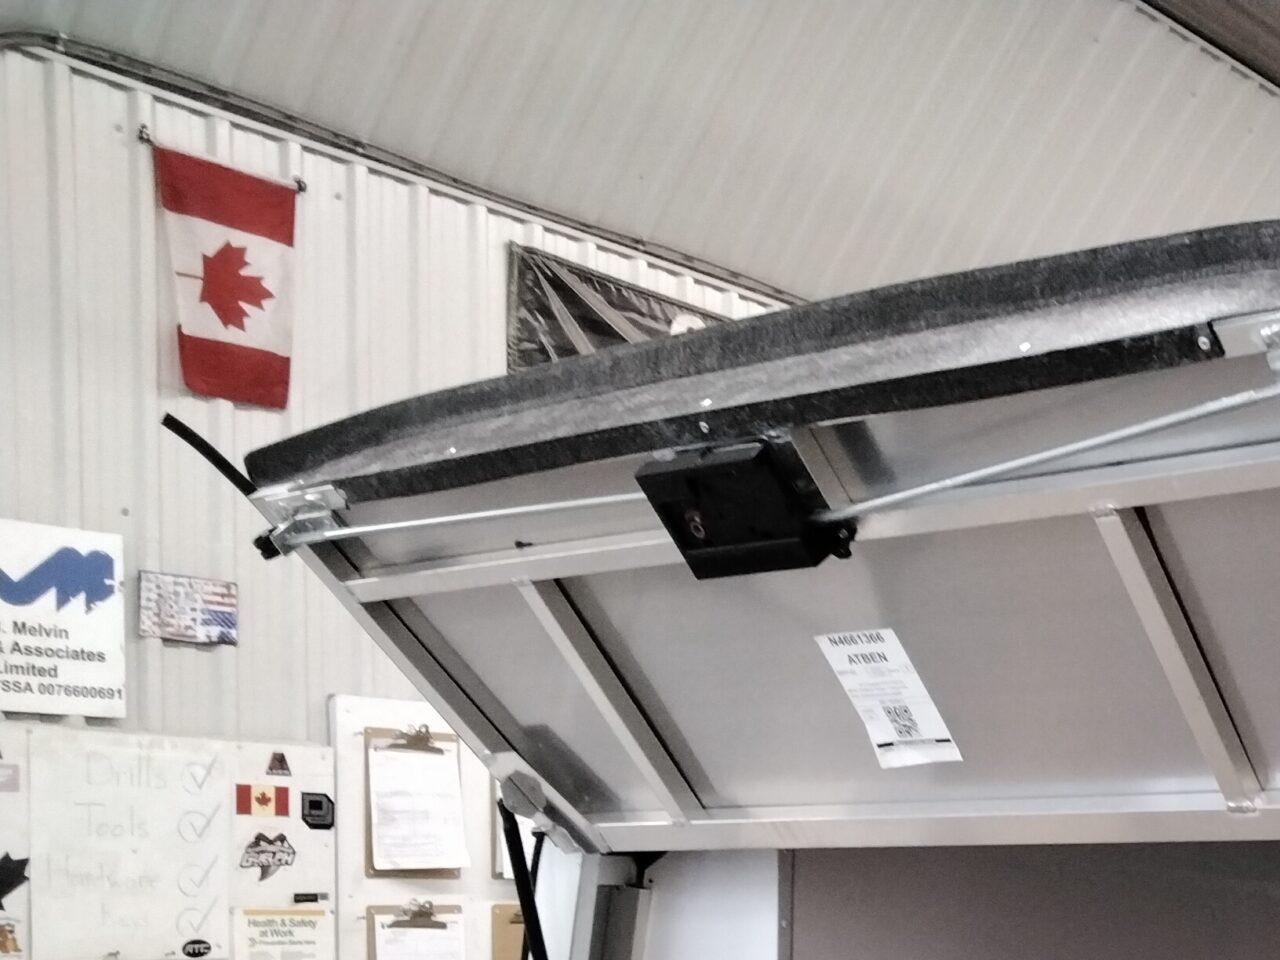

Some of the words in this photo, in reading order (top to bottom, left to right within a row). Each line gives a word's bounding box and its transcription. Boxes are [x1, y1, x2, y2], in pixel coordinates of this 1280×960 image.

[12, 620, 70, 640] Melvin
[10, 640, 107, 662] Associates
[0, 660, 58, 678] imited
[0, 679, 35, 694] SSA
[38, 682, 123, 700] 0076600691
[73, 801, 150, 838] Tools
